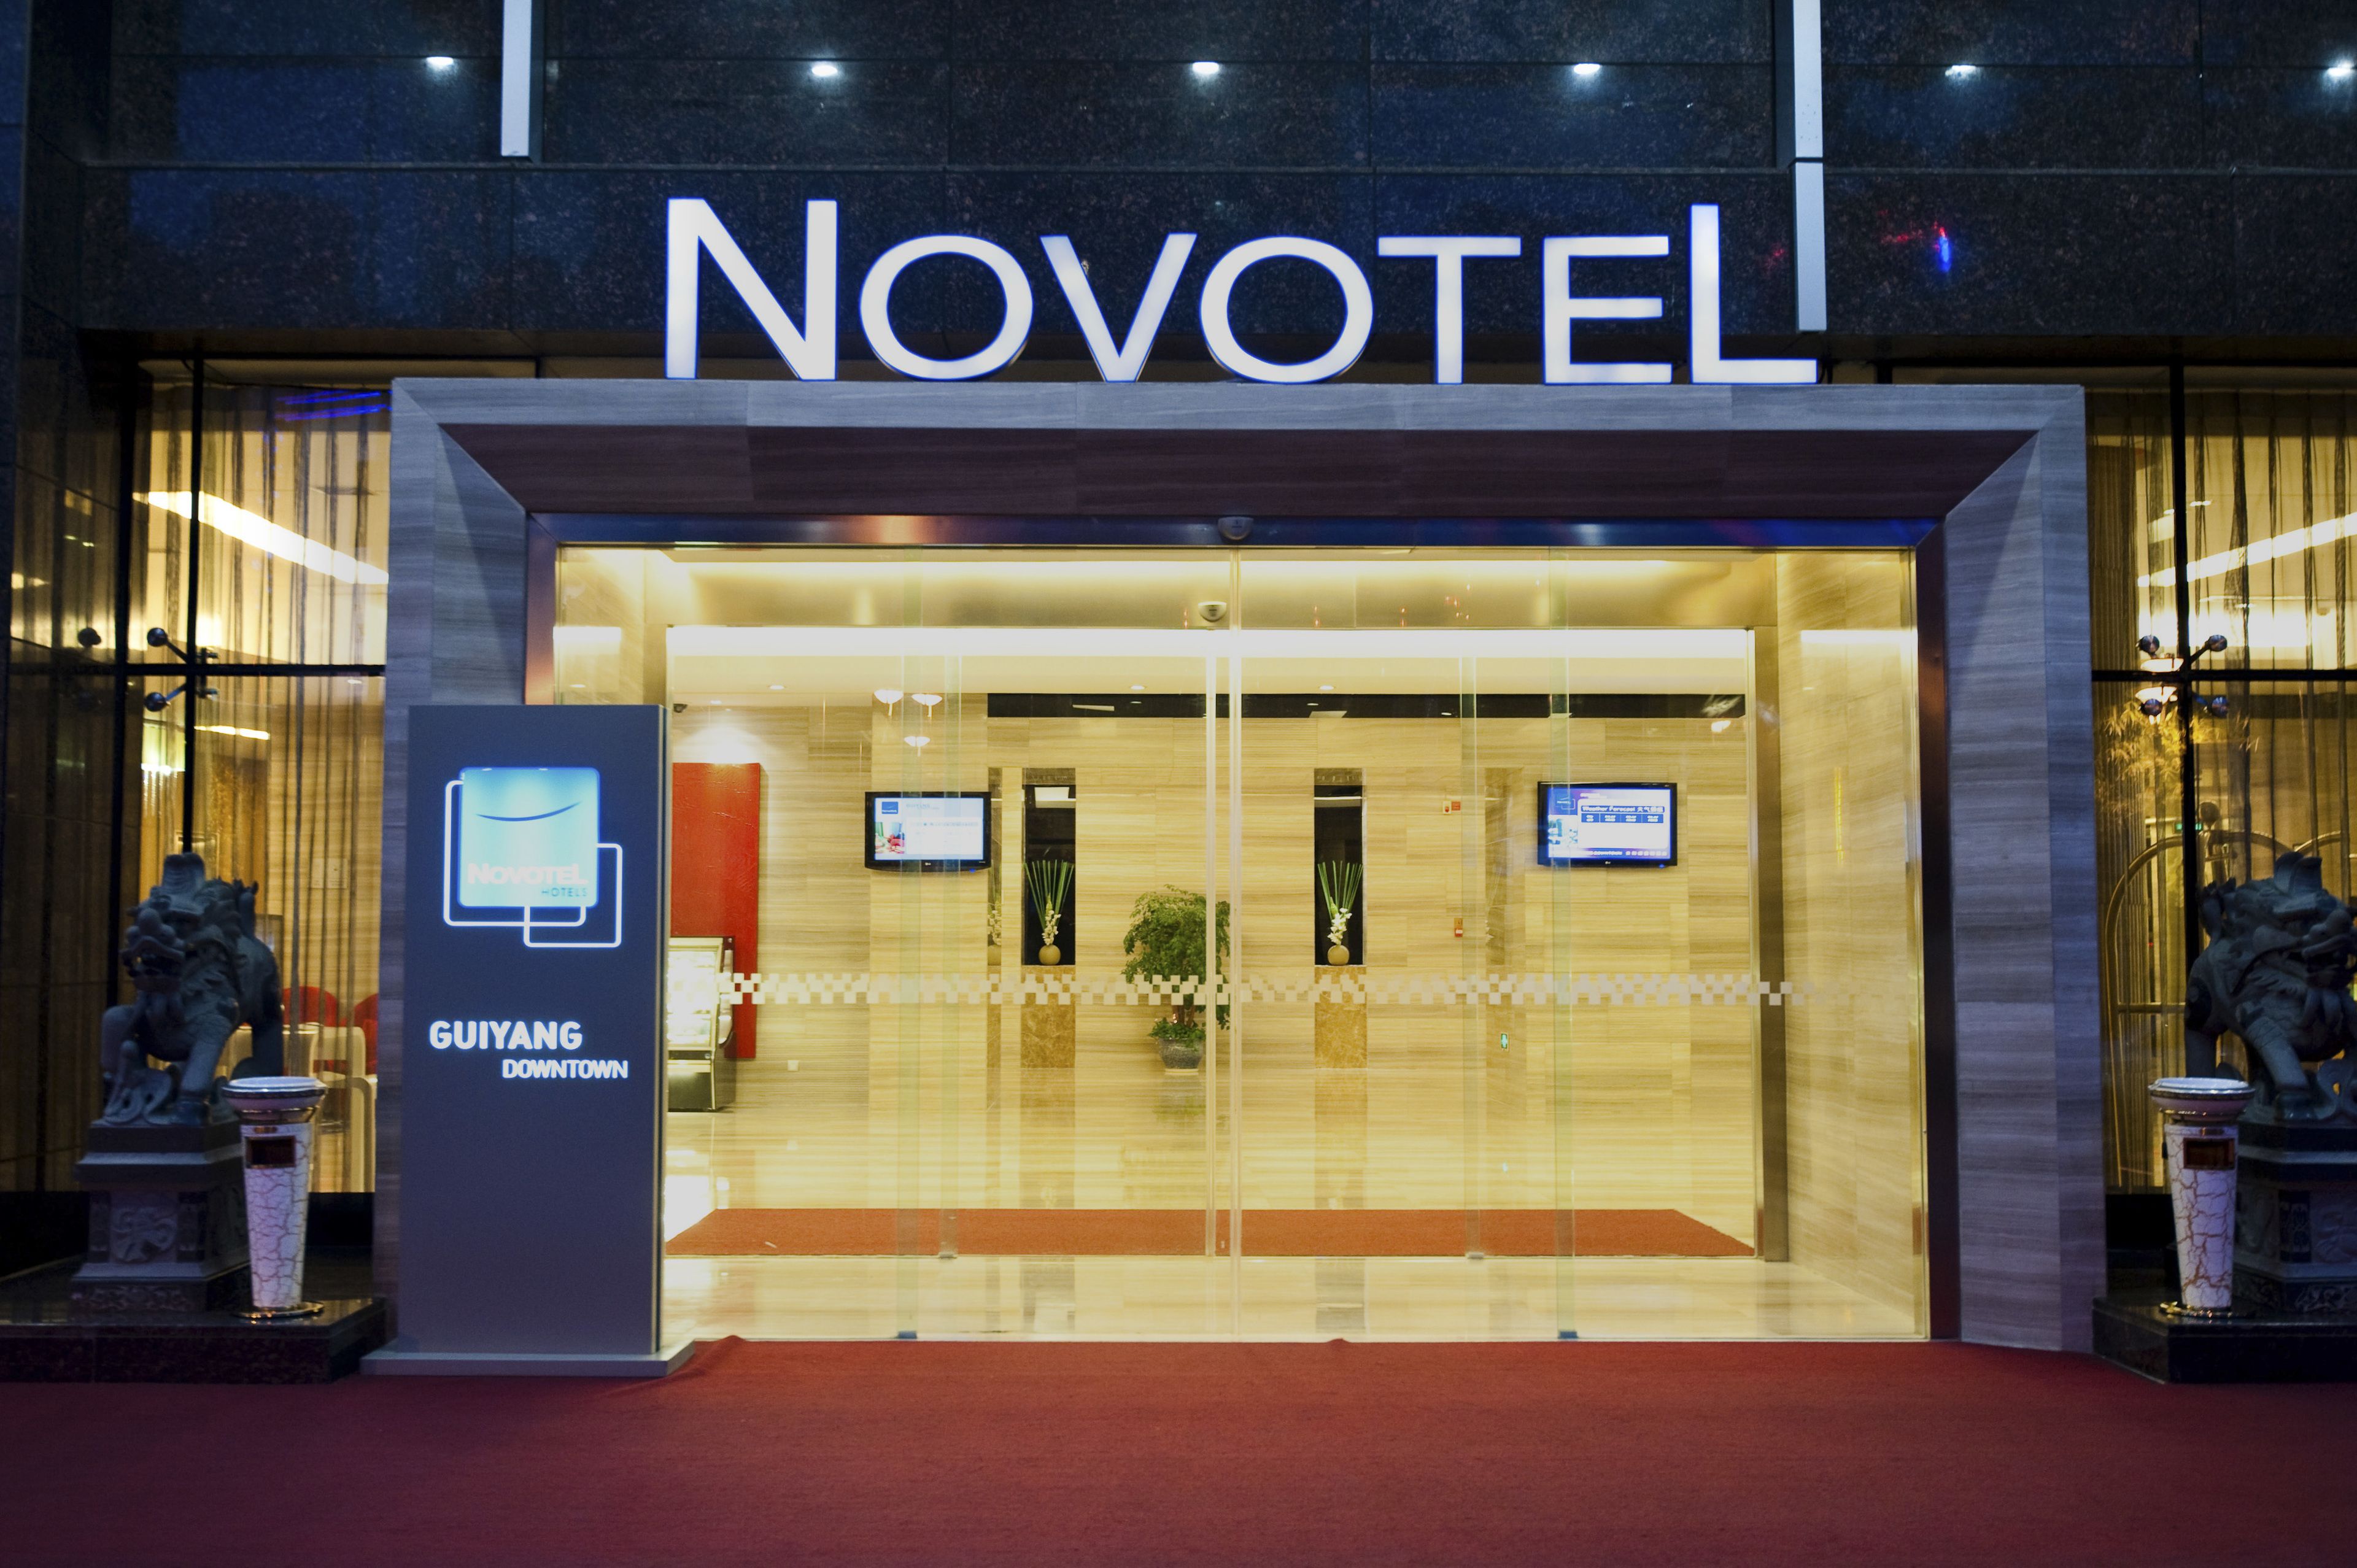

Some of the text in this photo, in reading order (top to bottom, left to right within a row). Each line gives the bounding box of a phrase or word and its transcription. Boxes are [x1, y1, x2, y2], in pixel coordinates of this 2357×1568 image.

[664, 197, 1819, 385] NOVOTEL
[467, 863, 589, 885] NOVOTEL
[541, 887, 587, 897] HOTELS
[429, 1021, 582, 1050] GUIYANG
[501, 1059, 628, 1079] DOWNTOWN
